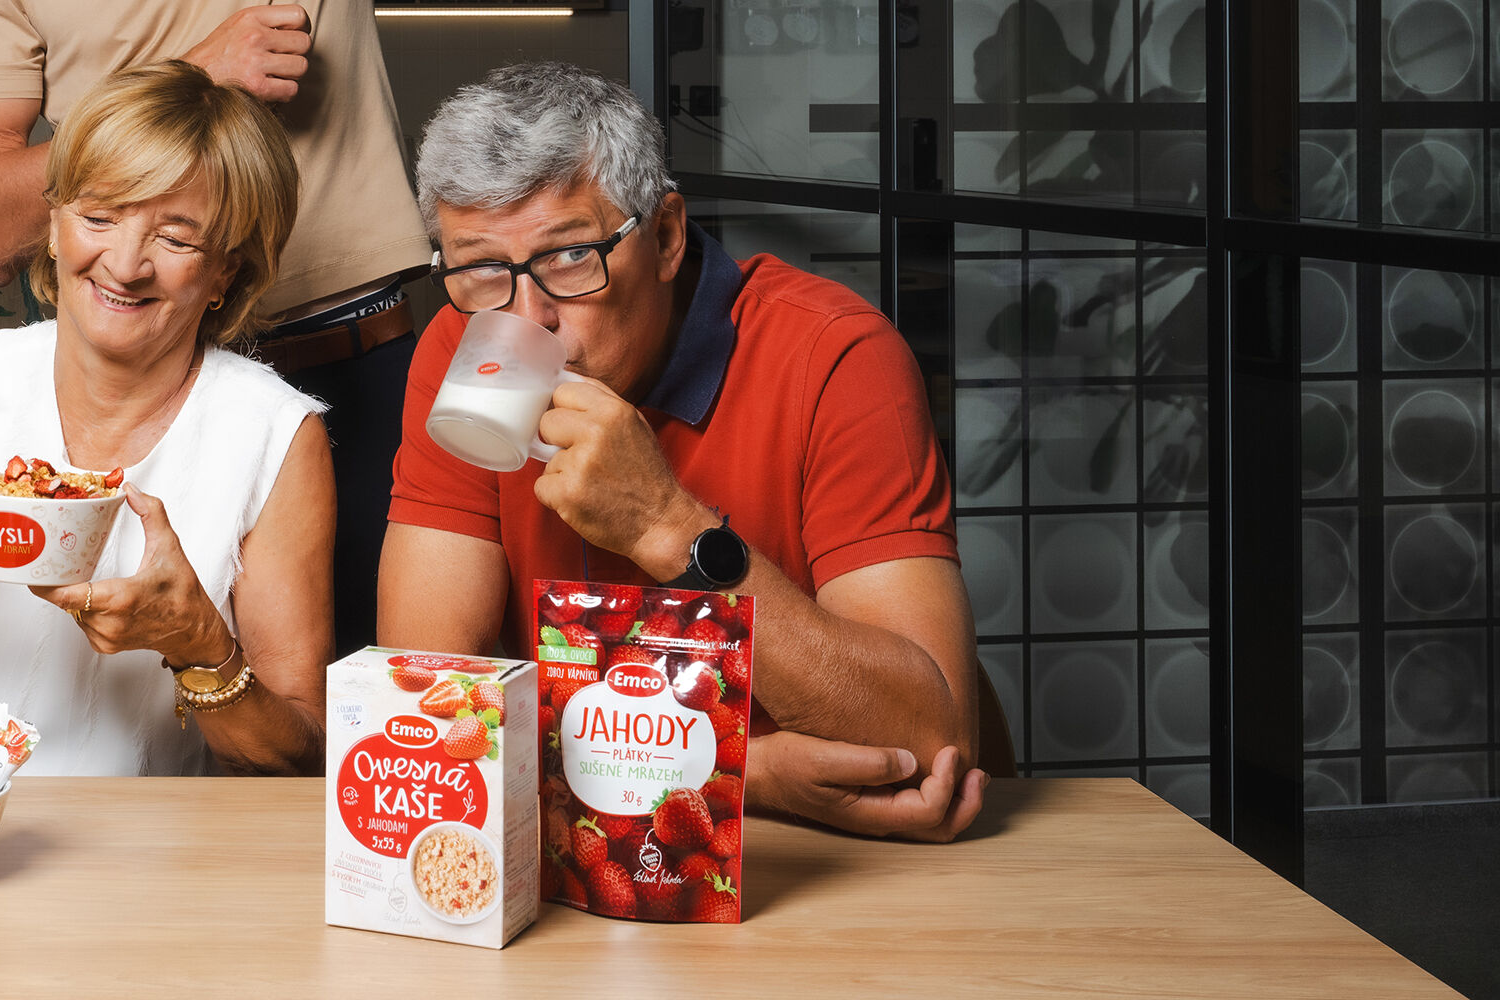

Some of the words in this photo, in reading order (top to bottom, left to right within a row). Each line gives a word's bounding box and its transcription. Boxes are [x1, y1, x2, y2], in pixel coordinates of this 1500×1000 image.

[570, 650, 594, 662] OVOCE
[546, 666, 566, 680] ZDROJ
[567, 666, 598, 682] VÁPNÍKU
[614, 672, 661, 690] Emco
[391, 721, 434, 739] Emco
[574, 707, 697, 750] JAHODY
[612, 748, 653, 762] PLÁTKY
[353, 750, 469, 792] Ovesná
[579, 761, 624, 778] SUŠENÉ
[628, 766, 683, 782] MRAZEM
[374, 784, 443, 820] KAŠE
[621, 790, 634, 804] 30
[357, 816, 363, 828] S
[367, 817, 408, 835] JAHODAMI
[372, 835, 395, 851] 5x55
